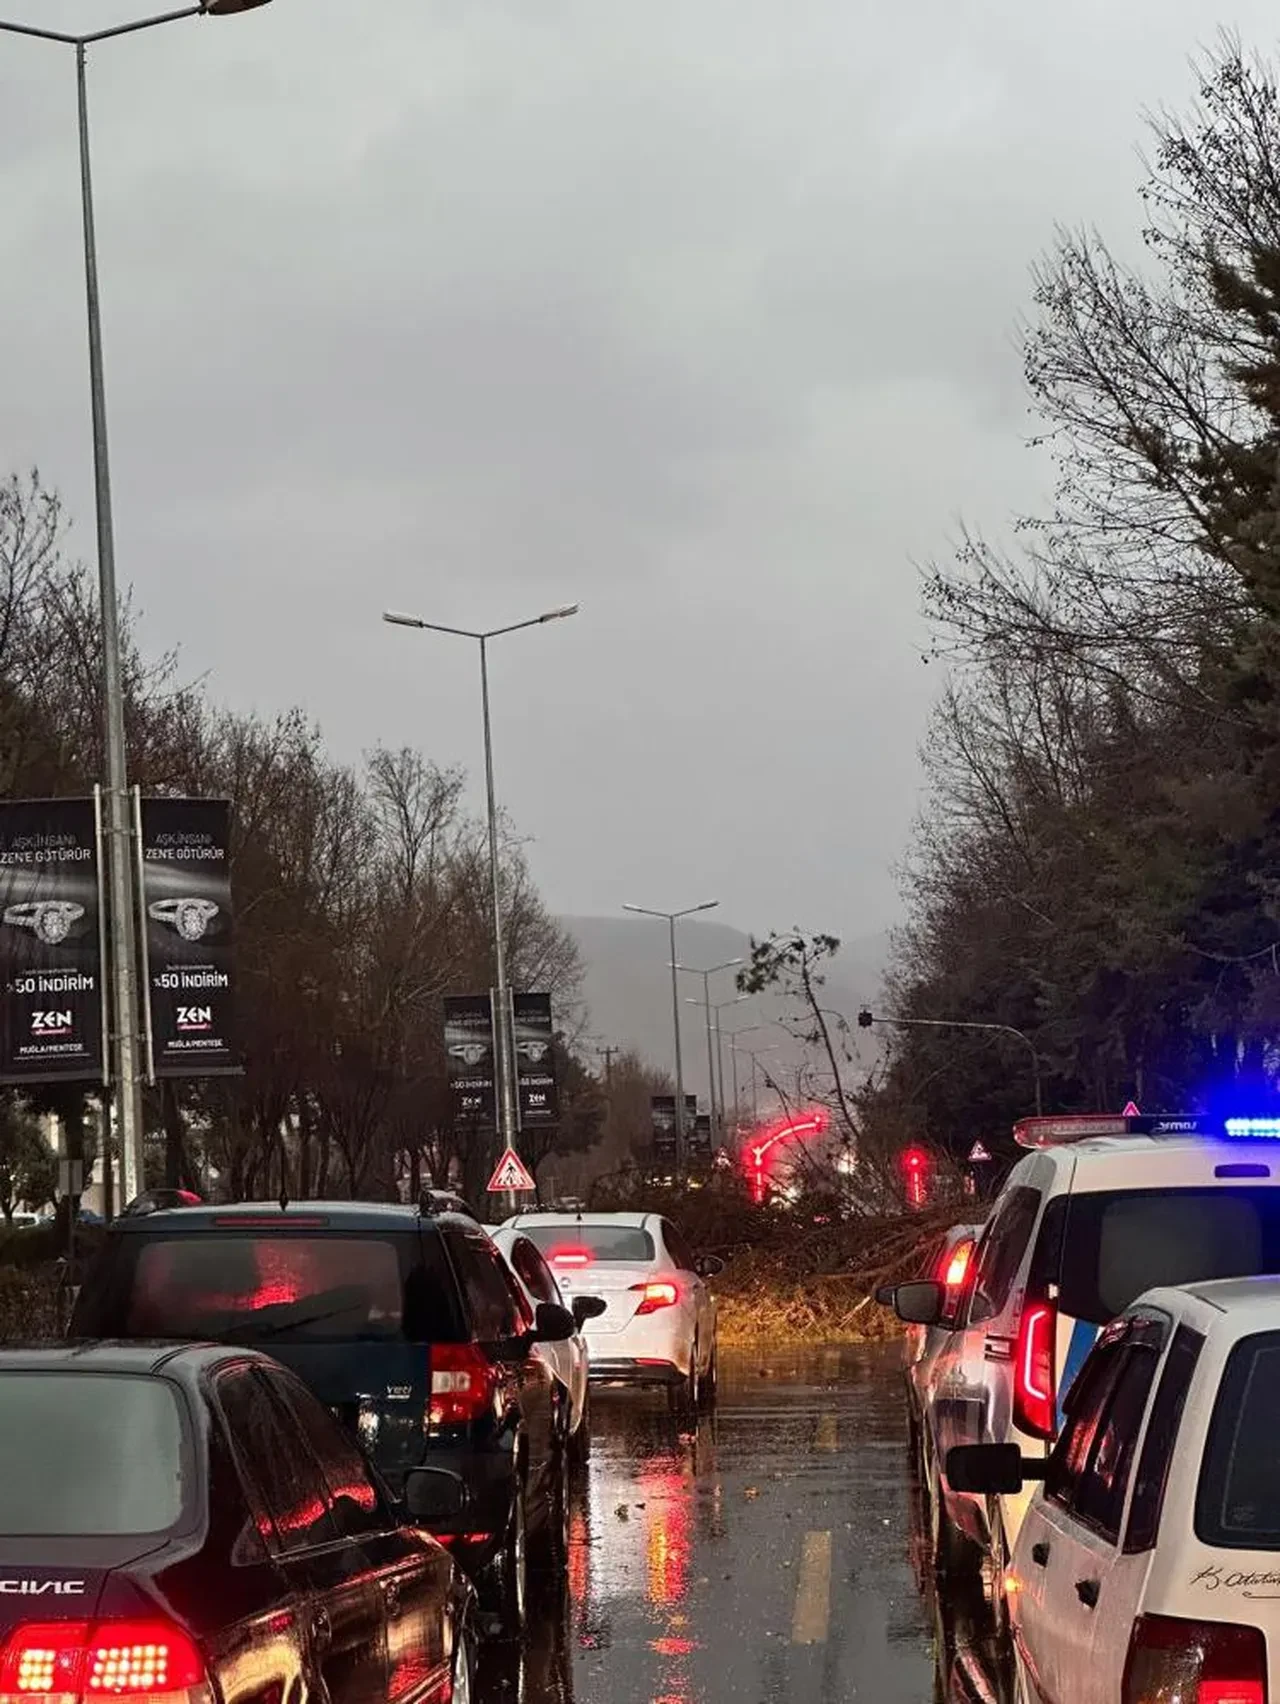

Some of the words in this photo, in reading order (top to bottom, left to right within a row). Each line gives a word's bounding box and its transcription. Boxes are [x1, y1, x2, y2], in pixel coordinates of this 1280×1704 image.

[176, 846, 225, 860] GÖTÜRÜR
[38, 974, 94, 992] İNDİRİM
[181, 970, 228, 988] İNDİRİM
[31, 1010, 72, 1028] ZEN
[176, 1006, 212, 1023] ZEN
[0, 1580, 84, 1595] CIVIC
